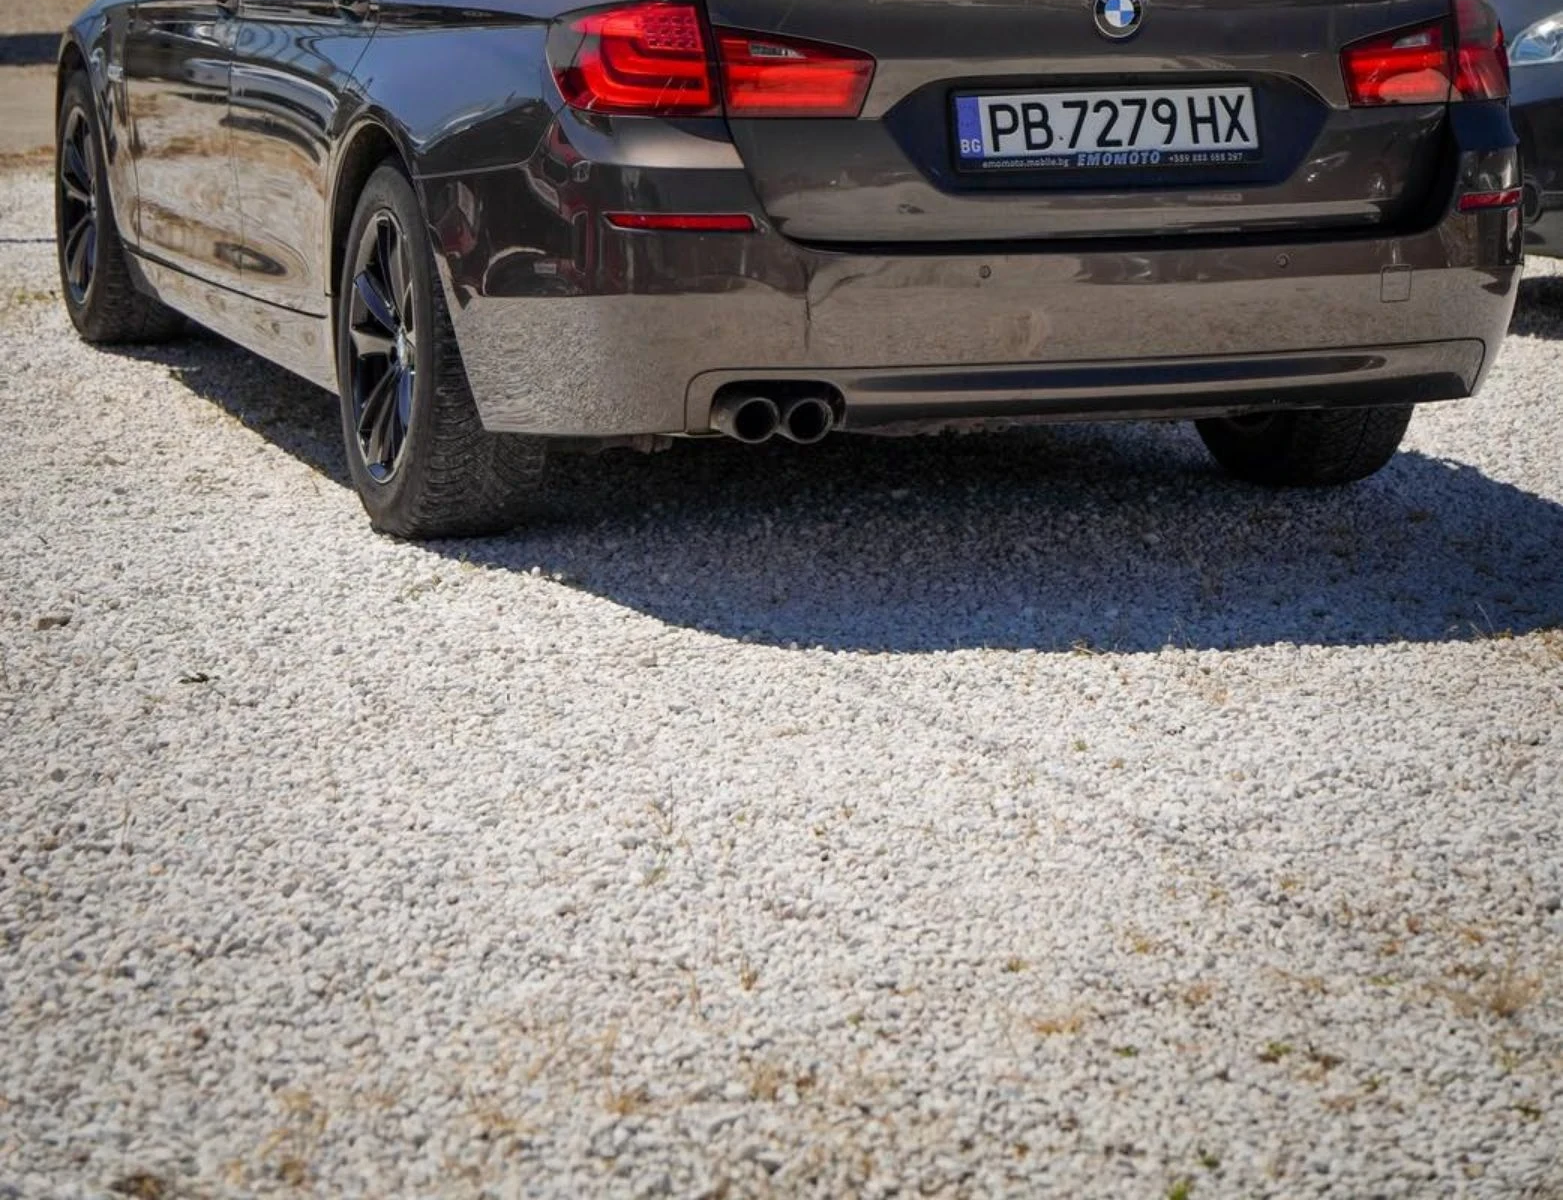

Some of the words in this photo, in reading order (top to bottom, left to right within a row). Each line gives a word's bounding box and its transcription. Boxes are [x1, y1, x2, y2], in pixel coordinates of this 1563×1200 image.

[1063, 97, 1178, 149] 7279
[1187, 94, 1250, 145] HX
[960, 138, 982, 154] BG
[1077, 151, 1160, 166] EMOMOTO
